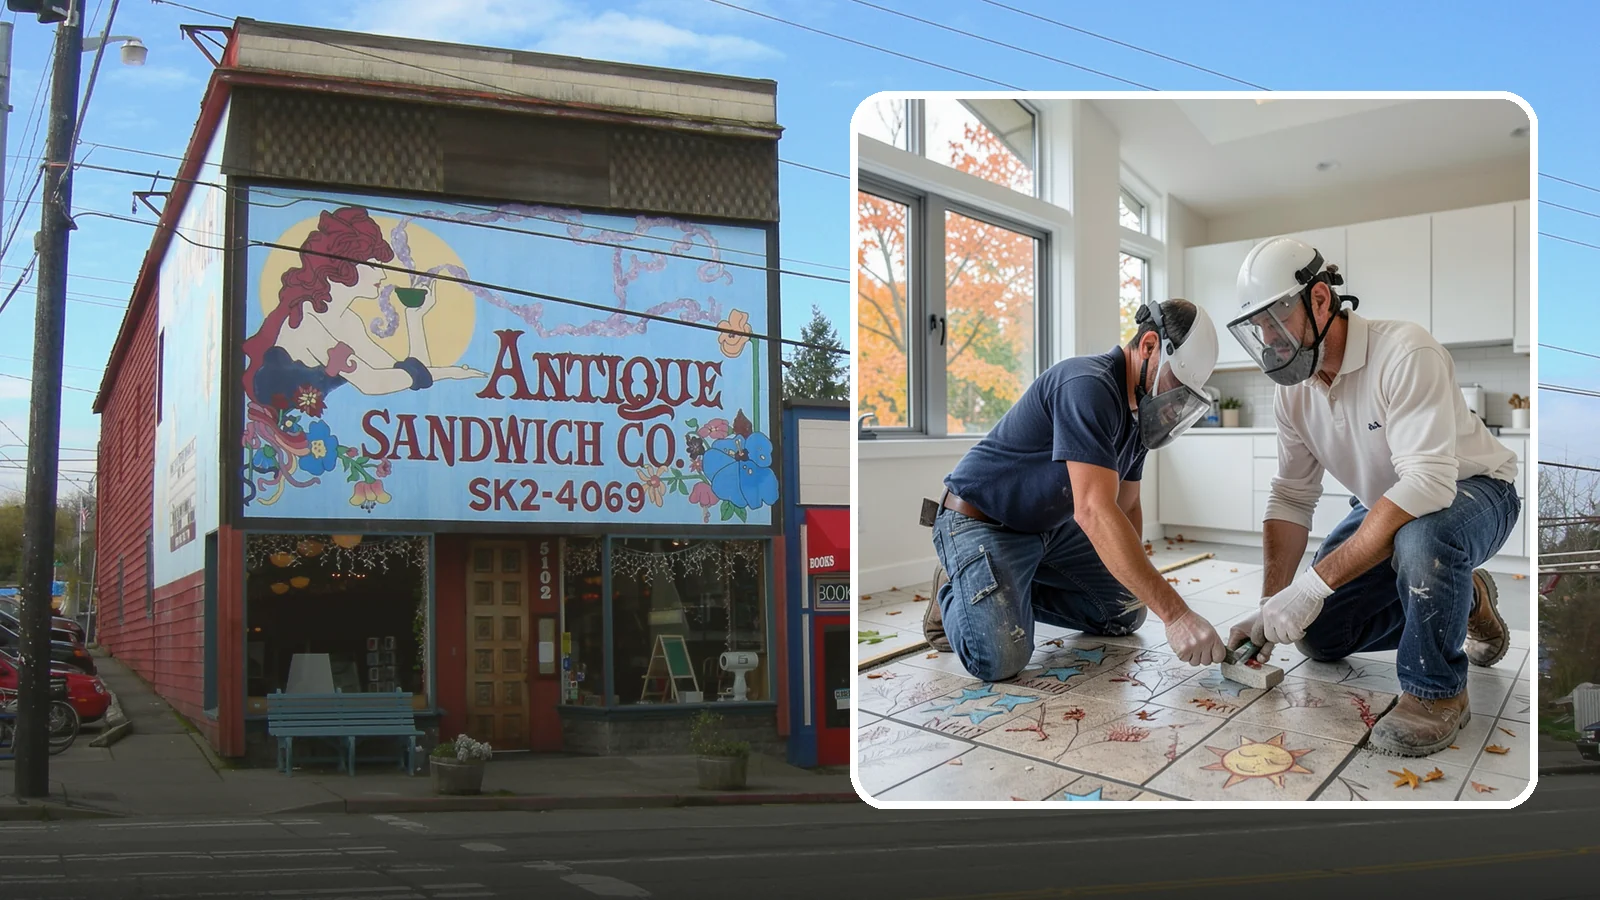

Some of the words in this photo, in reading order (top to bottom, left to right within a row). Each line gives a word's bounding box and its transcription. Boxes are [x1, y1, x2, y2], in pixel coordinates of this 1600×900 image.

[476, 329, 723, 420] ANTIQUE
[361, 408, 604, 467] SANDWICH
[617, 422, 684, 469] CO.
[468, 477, 645, 513] SK2-4069
[540, 542, 551, 599] 5102
[809, 555, 835, 569] BOOKS
